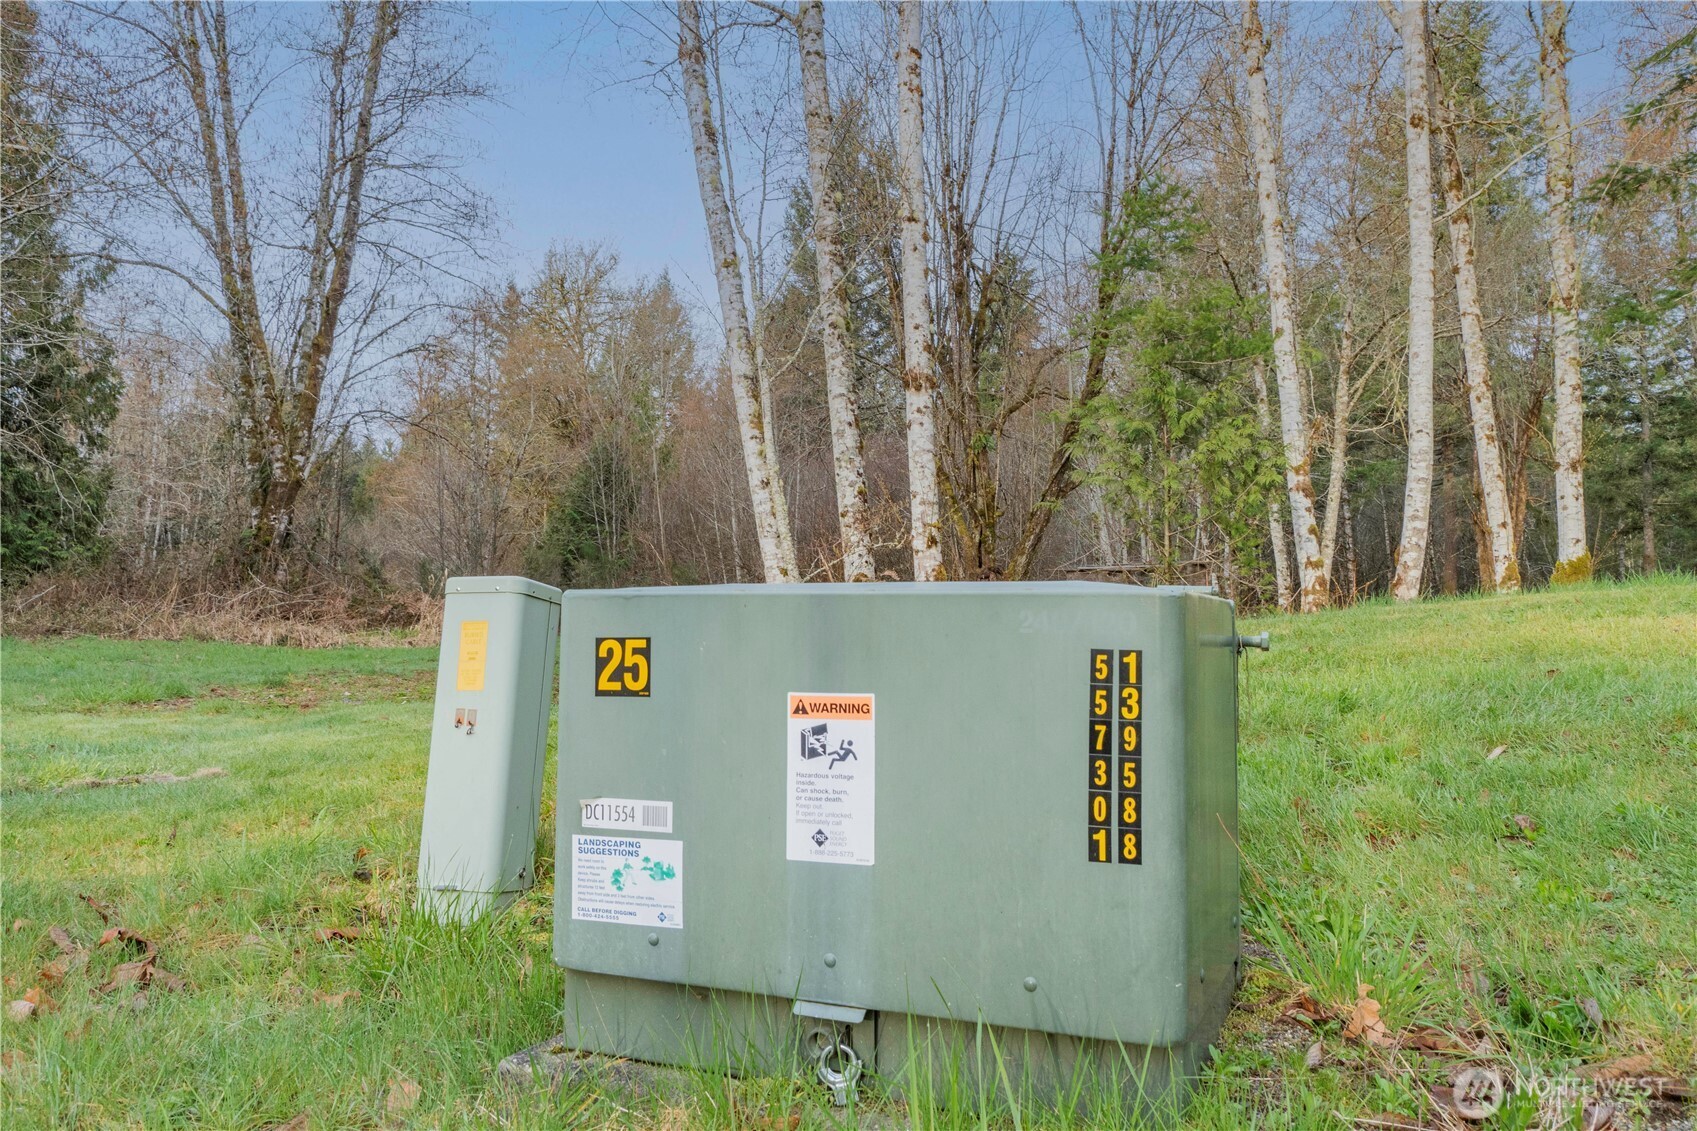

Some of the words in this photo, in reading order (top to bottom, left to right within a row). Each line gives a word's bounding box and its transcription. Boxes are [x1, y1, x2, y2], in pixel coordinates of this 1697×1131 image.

[598, 639, 649, 691] 25
[809, 702, 870, 714] WARNING
[831, 773, 854, 781] voltage
[585, 804, 635, 822] DC11554
[578, 838, 641, 849] LANDSCAPING
[578, 847, 640, 857] SUGGESTIONS
